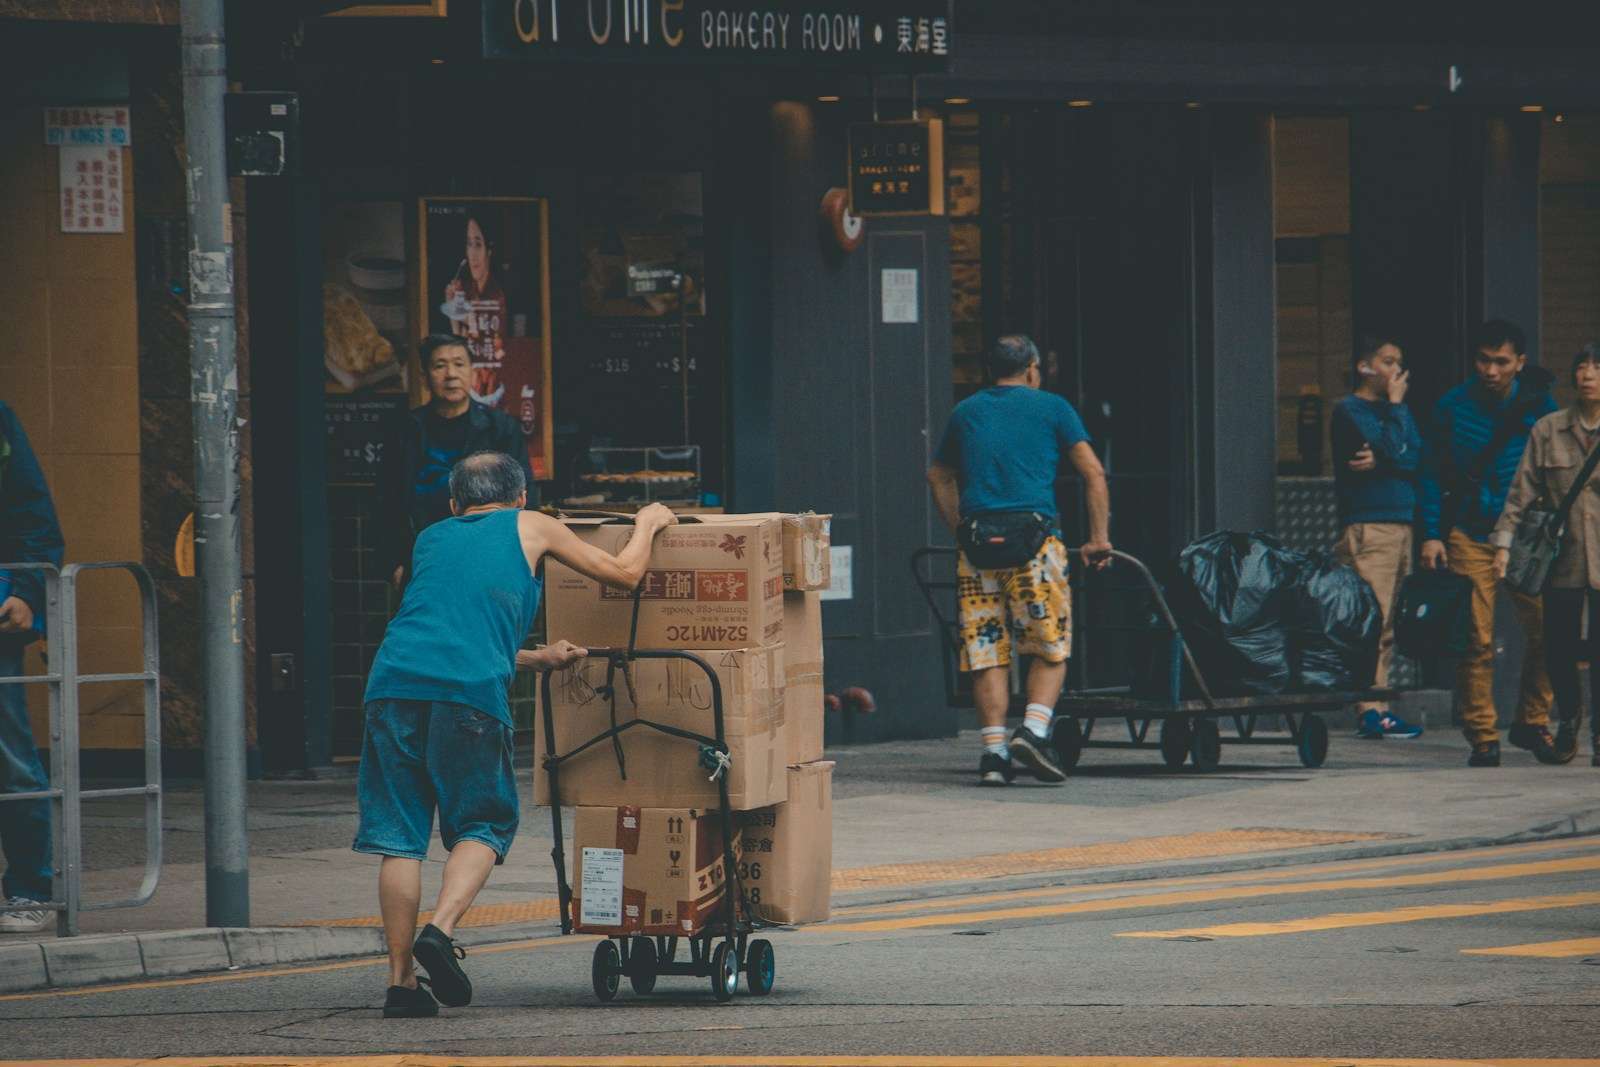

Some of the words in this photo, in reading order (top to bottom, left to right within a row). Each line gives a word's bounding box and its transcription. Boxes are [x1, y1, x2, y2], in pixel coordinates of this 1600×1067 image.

[700, 9, 791, 50] BAKERY
[802, 13, 862, 51] ROOM
[896, 16, 947, 54] 東海堂
[667, 625, 749, 642] 524M12C
